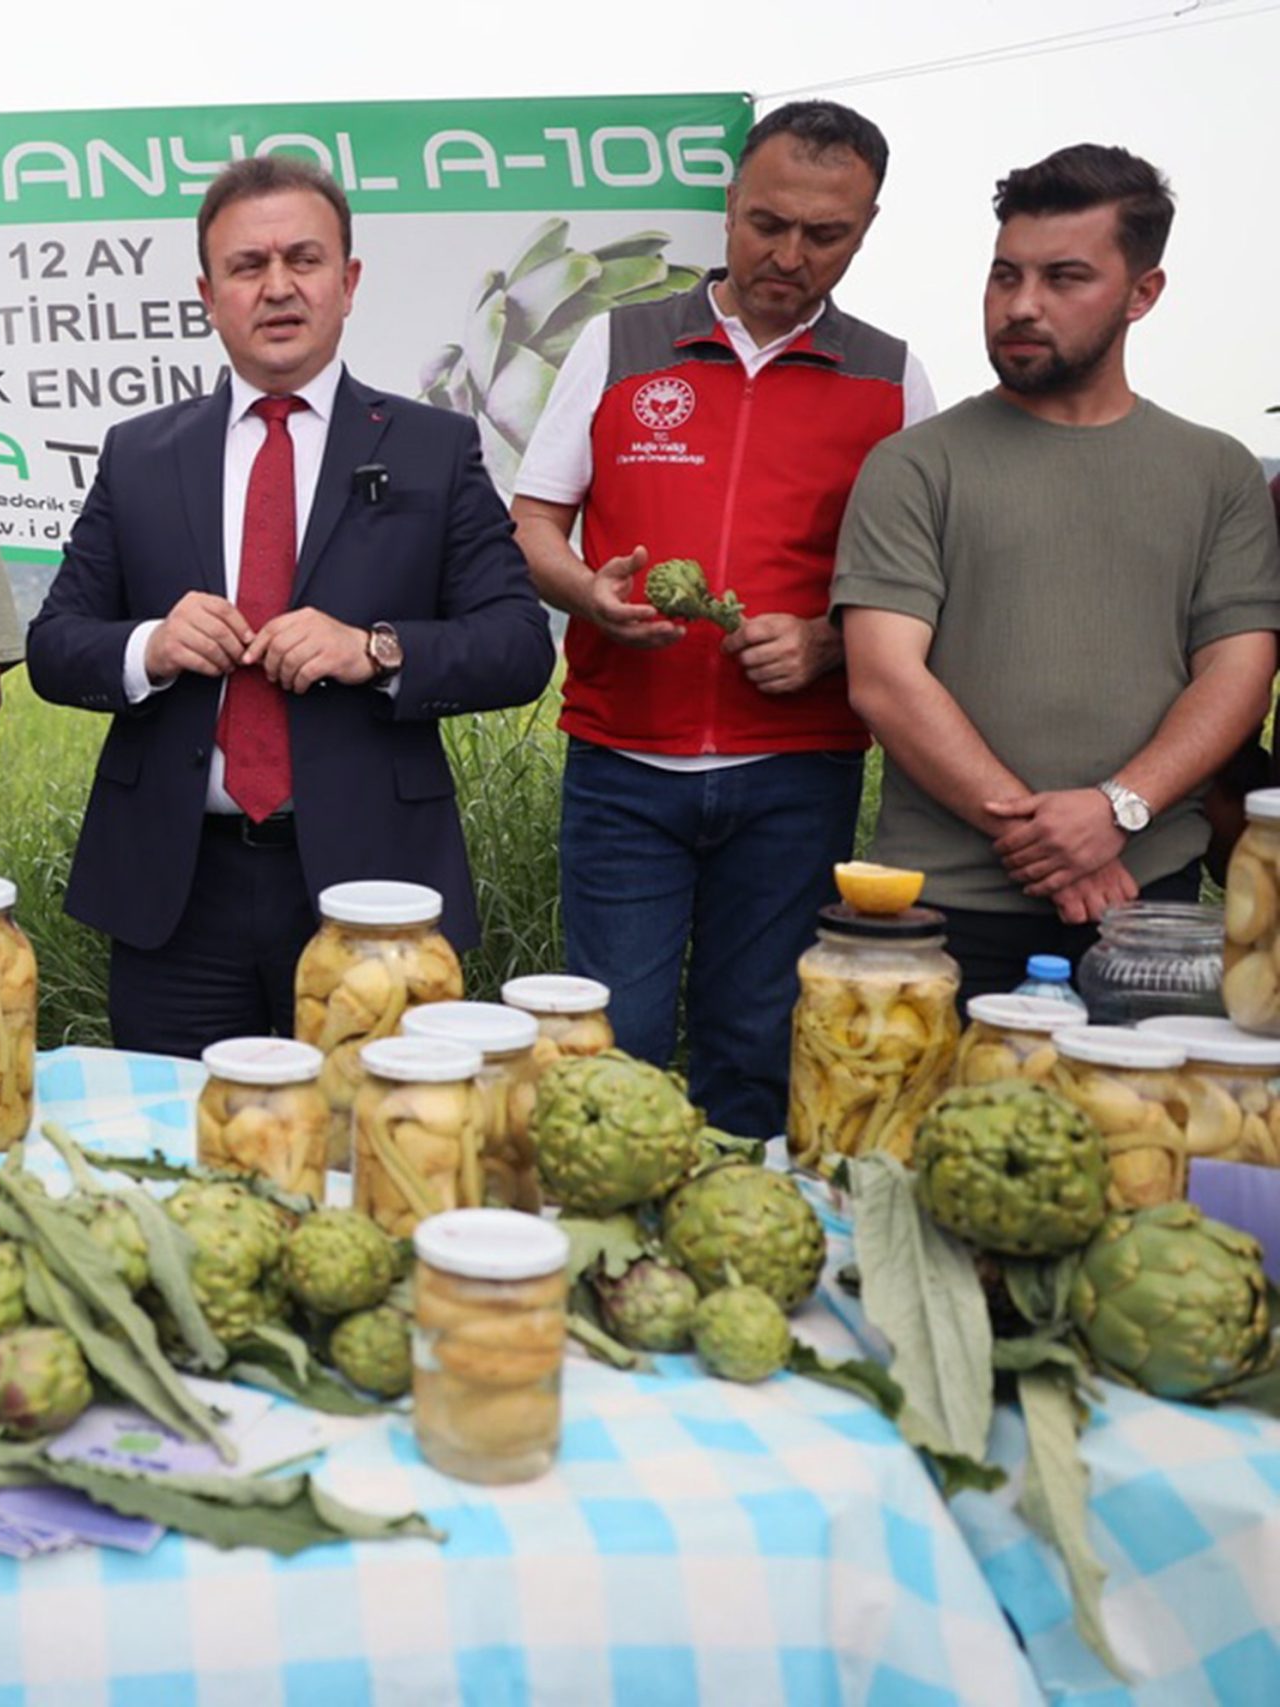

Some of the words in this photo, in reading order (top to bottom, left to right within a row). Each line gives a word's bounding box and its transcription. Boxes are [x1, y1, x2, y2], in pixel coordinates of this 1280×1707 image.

[423, 125, 734, 190] A-106
[8, 240, 67, 280] 12
[85, 237, 154, 277] AY
